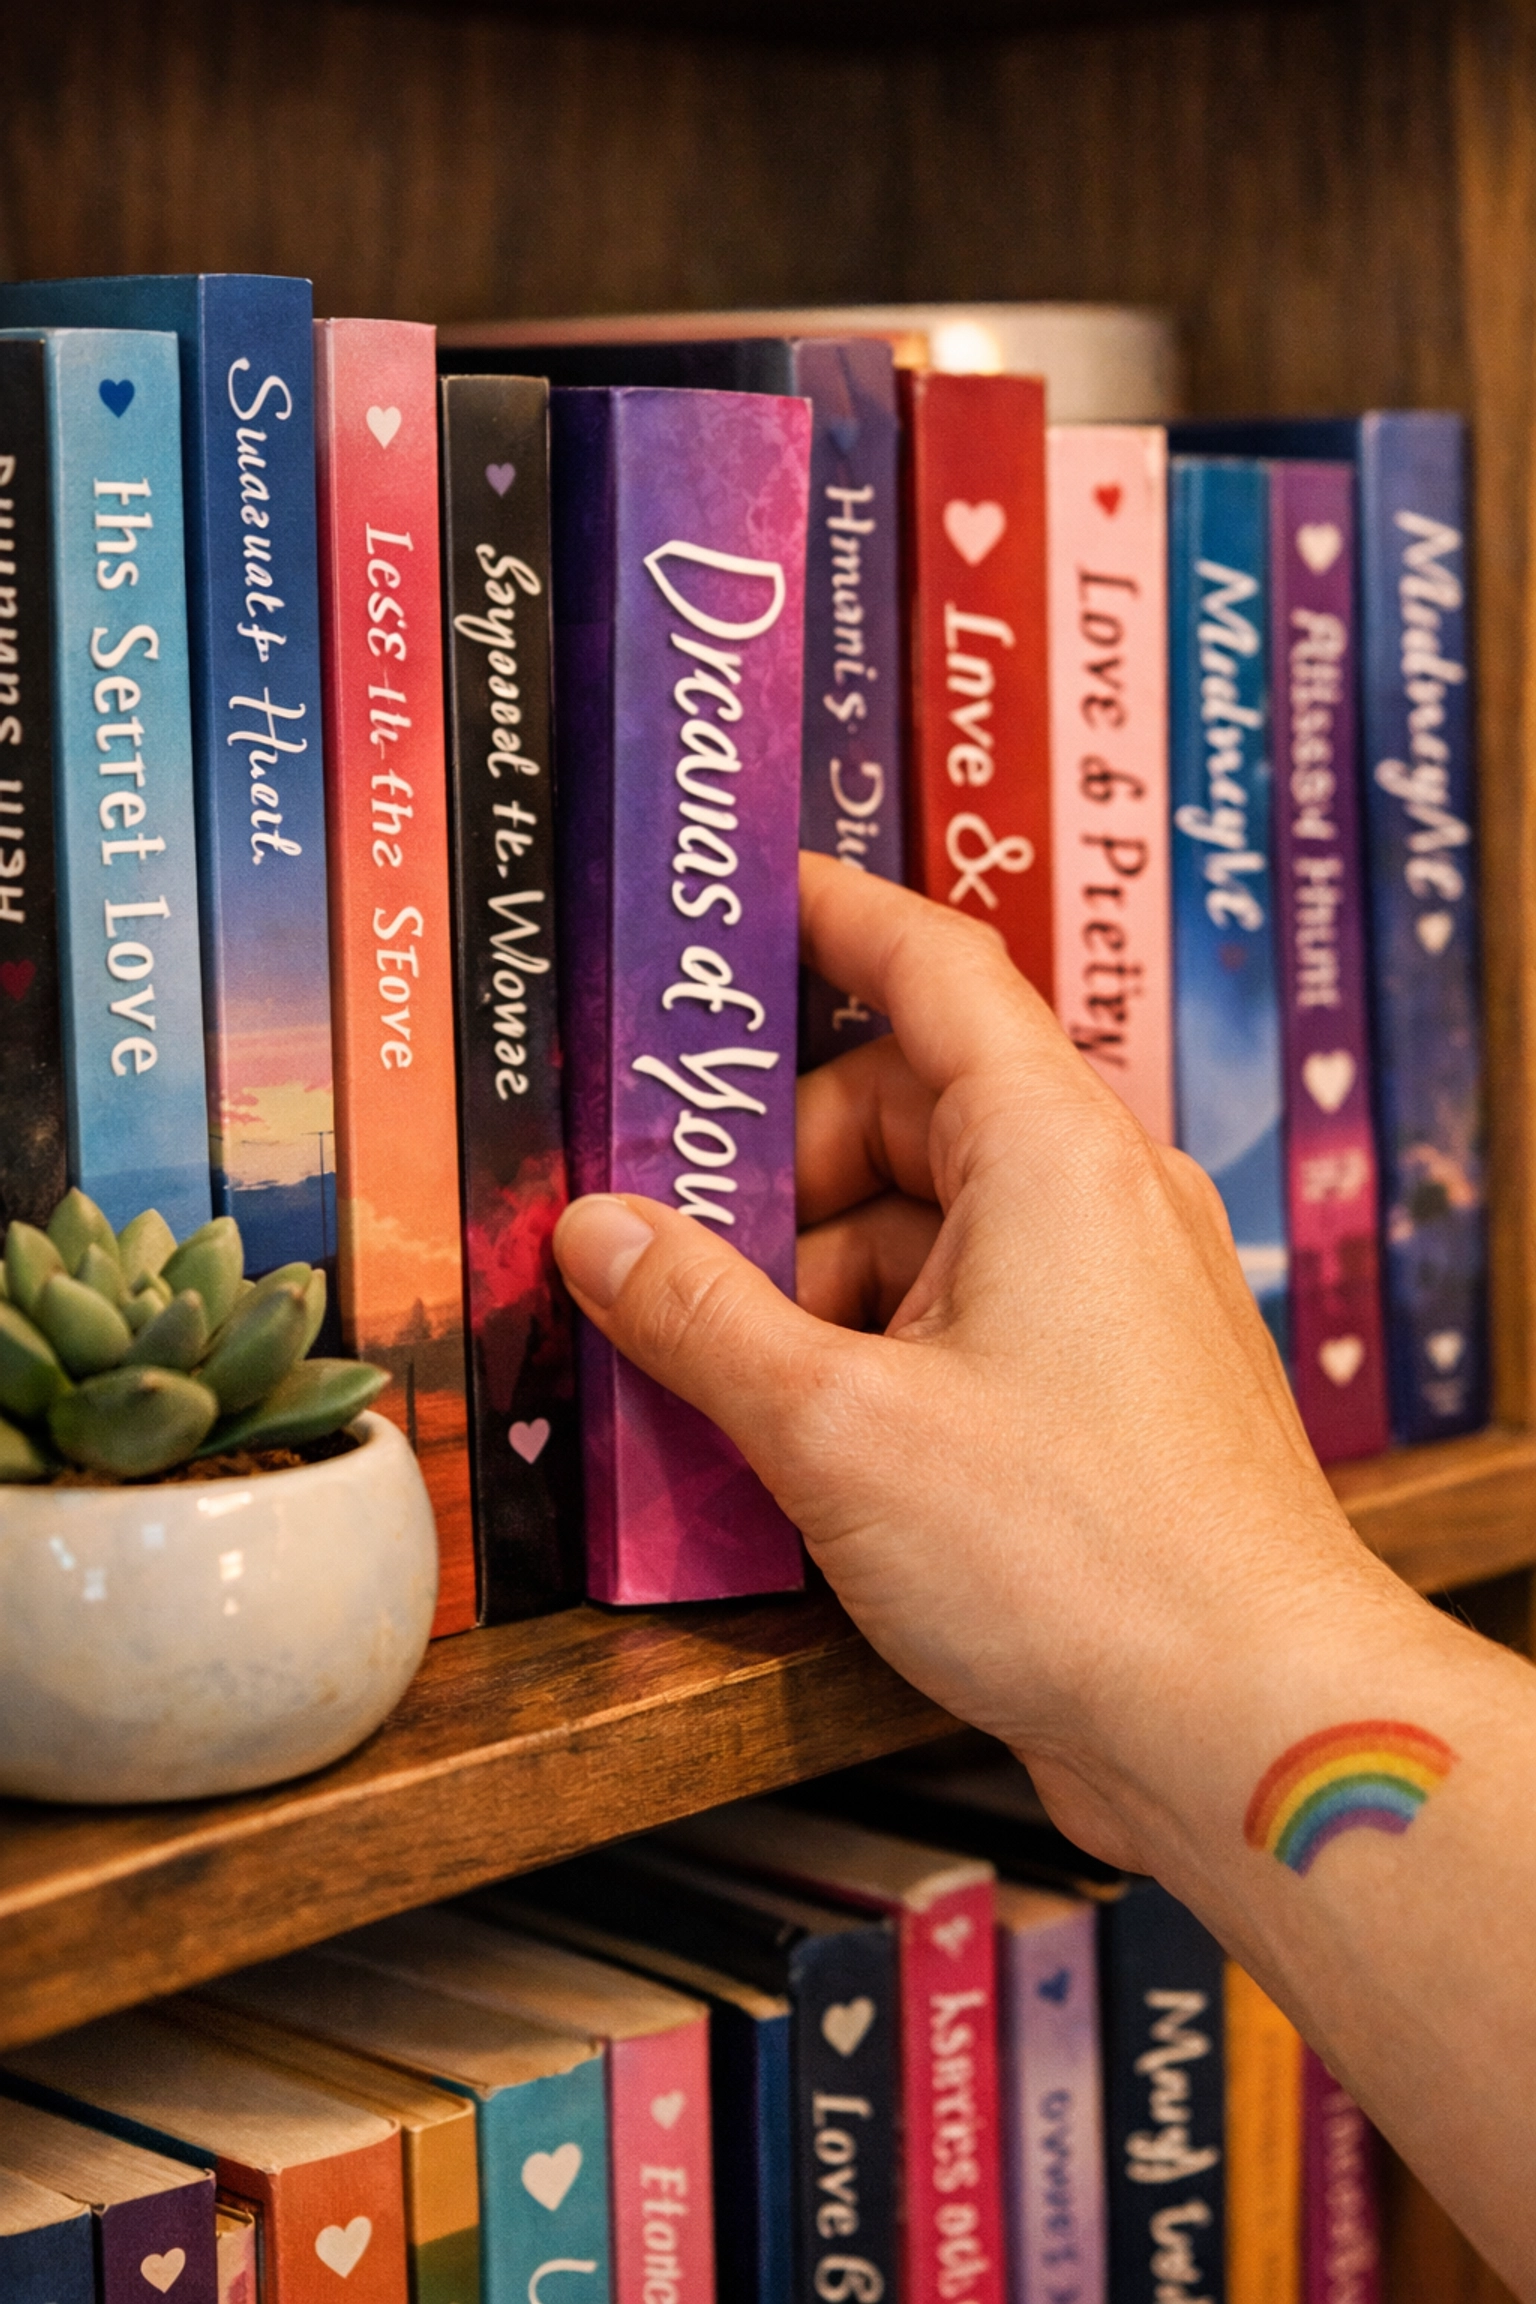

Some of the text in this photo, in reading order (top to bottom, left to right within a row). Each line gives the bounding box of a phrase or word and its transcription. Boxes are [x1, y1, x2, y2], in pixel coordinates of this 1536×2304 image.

[944, 811, 1035, 912] &
[105, 893, 173, 1076] Love
[661, 944, 766, 1032] of
[631, 1046, 780, 1230] You
[811, 2092, 873, 2239] Love
